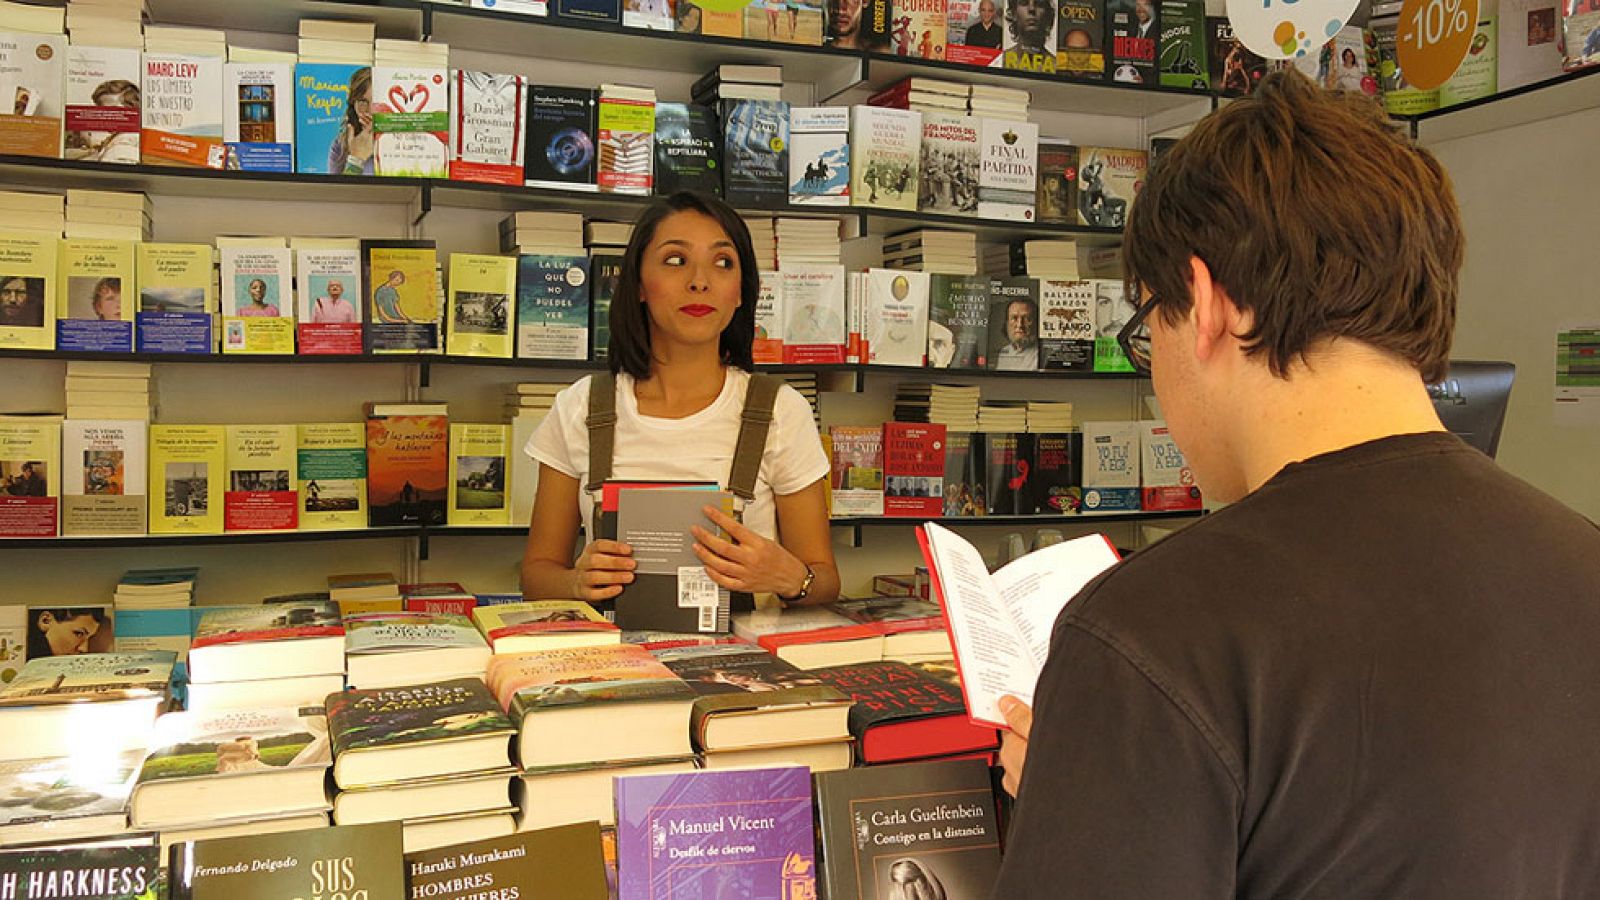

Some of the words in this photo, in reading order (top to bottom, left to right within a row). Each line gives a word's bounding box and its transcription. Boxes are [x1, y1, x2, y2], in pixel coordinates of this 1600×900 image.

[1060, 6, 1096, 20] OPEN
[1403, 0, 1469, 49] -10%
[1005, 51, 1056, 74] RAFA
[147, 62, 174, 78] MARC
[175, 63, 198, 79] LEVY
[147, 79, 160, 94] LOS
[147, 96, 156, 109] DE
[159, 96, 194, 111] NUESTRO
[307, 95, 343, 116] Keyes
[473, 102, 505, 116] David
[147, 113, 183, 128] INFINITO
[464, 114, 514, 129] Grossman
[923, 123, 939, 131] LOS
[940, 125, 963, 134] MITOS
[964, 127, 977, 136] DEL
[474, 132, 500, 144] Gran
[923, 131, 977, 143] FRANQUISMO
[466, 143, 508, 156] Cabaret
[990, 145, 1027, 159] FINAL
[983, 160, 1035, 177] PARTIDA
[538, 261, 553, 269] LA
[554, 261, 572, 270] LUZ
[545, 274, 565, 282] QUE
[1044, 291, 1093, 299] BALTASAR
[536, 299, 573, 308] PUEDES
[952, 304, 986, 312] HITLER
[544, 311, 563, 319] VER
[1059, 323, 1092, 332] FANGO
[833, 442, 850, 452] DEL
[1097, 446, 1110, 459] YO
[1151, 444, 1165, 457] YO
[1099, 459, 1107, 471] A
[1155, 457, 1163, 469] A
[872, 809, 907, 826] Carla
[910, 803, 984, 823] Guelfenbein
[669, 817, 724, 836] Manuel
[728, 816, 775, 831] Vicent
[873, 832, 916, 847] Contigo
[918, 832, 931, 841] en
[933, 828, 943, 840] la
[944, 824, 985, 839] distancia
[670, 844, 705, 859] Desfile
[707, 844, 719, 855] de
[722, 844, 757, 856] ciervos
[411, 858, 456, 876] Haruki
[459, 844, 526, 868] Murakami
[194, 861, 248, 878] Fernando
[250, 857, 298, 874] Delgado
[310, 856, 355, 895] SUS
[27, 866, 147, 900] HARKNESS
[412, 872, 494, 899] HOMBRES
